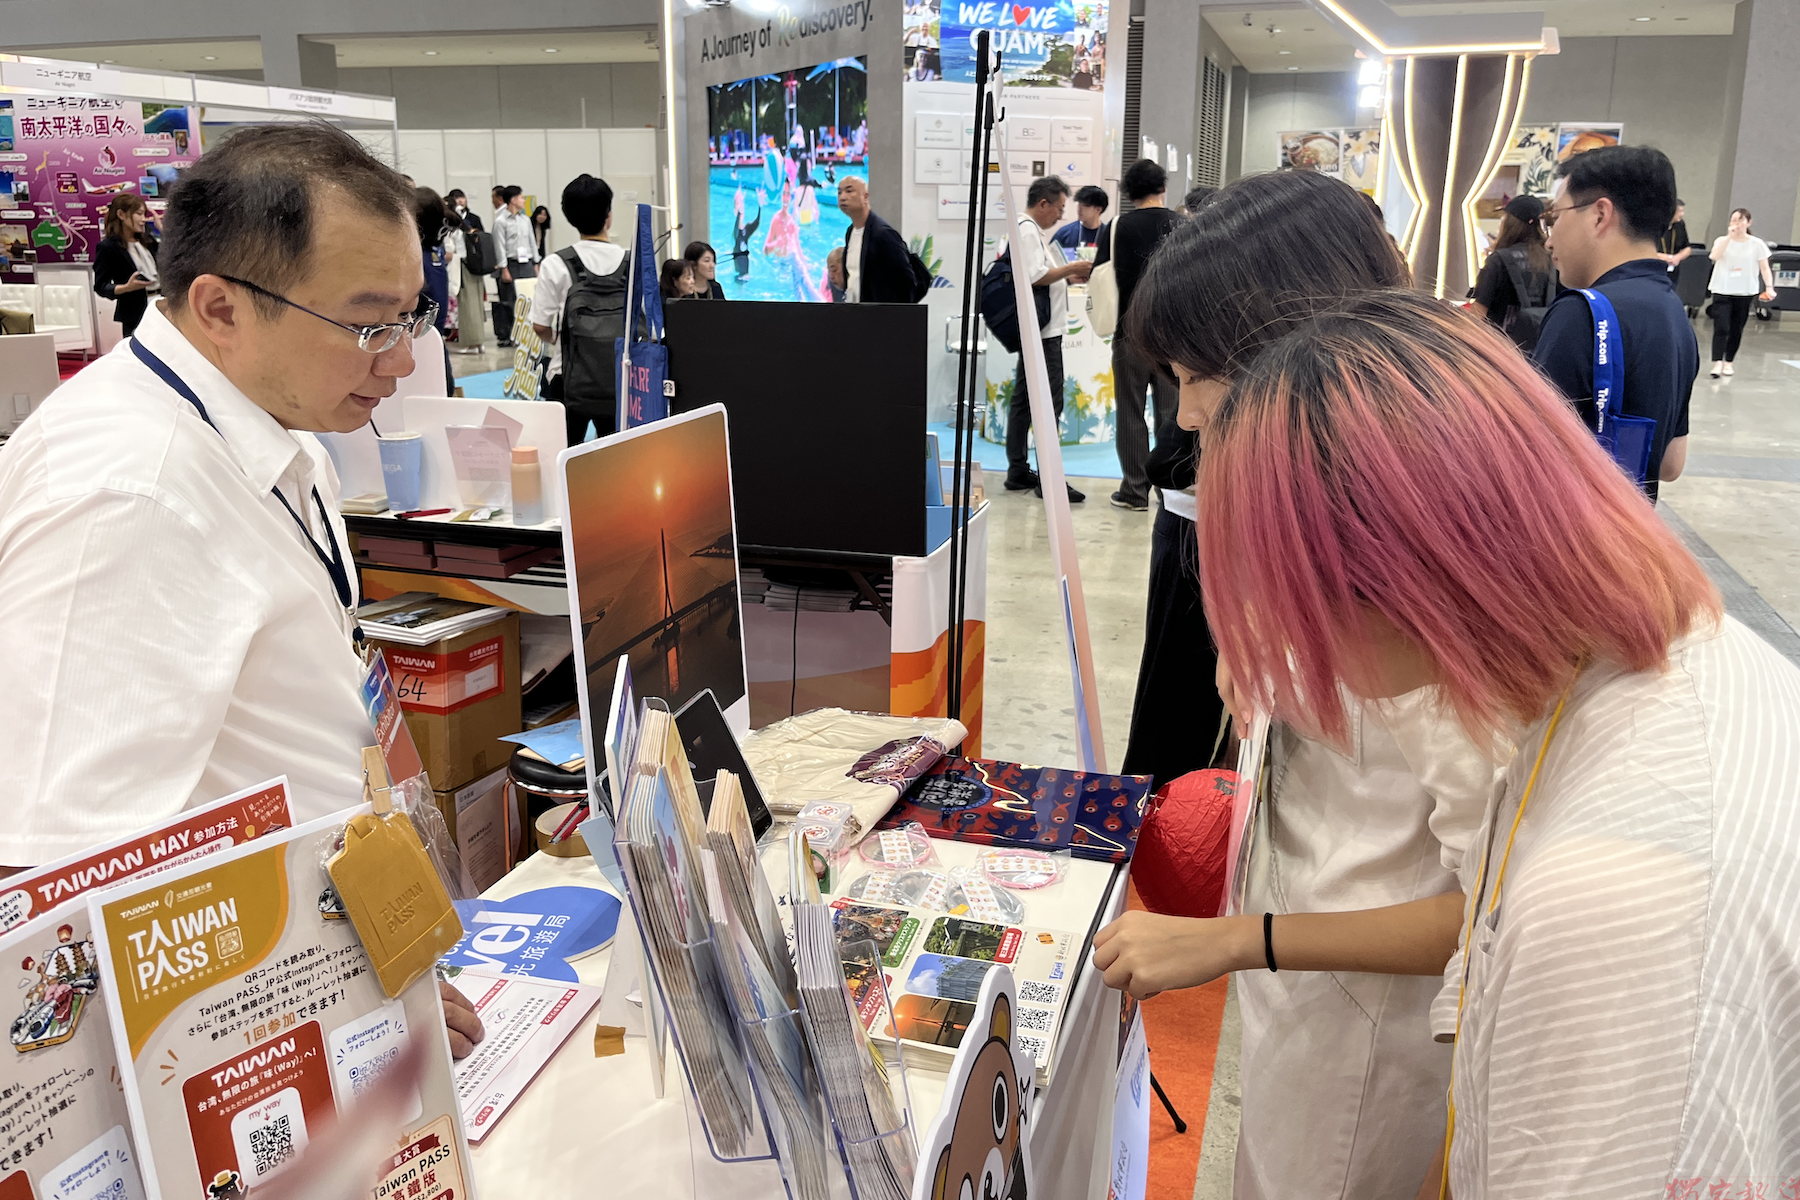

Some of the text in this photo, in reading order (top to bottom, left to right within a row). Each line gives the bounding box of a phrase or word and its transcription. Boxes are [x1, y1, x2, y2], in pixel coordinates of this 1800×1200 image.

[959, 2, 996, 24] WE
[701, 38, 710, 63] A
[711, 29, 757, 61] Journey
[759, 20, 772, 48] of
[36, 68, 92, 81] ニューギニア航空
[20, 115, 138, 140] 南太平洋の国々へ
[1597, 319, 1608, 365] Trip.com
[1596, 387, 1609, 433] Trip.com
[393, 655, 435, 669] TAIWAN
[397, 673, 427, 701] 64
[37, 848, 144, 903] TAIWAN
[149, 829, 191, 860] WAY
[120, 900, 159, 919] TAIWAN
[128, 897, 239, 959] TAIWAN
[137, 940, 209, 991] PASS
[199, 996, 235, 1017] Taiwan
[211, 1038, 296, 1088] TAIWAN
[248, 1098, 282, 1121] my way
[371, 1144, 451, 1200] Taiwan PASS
